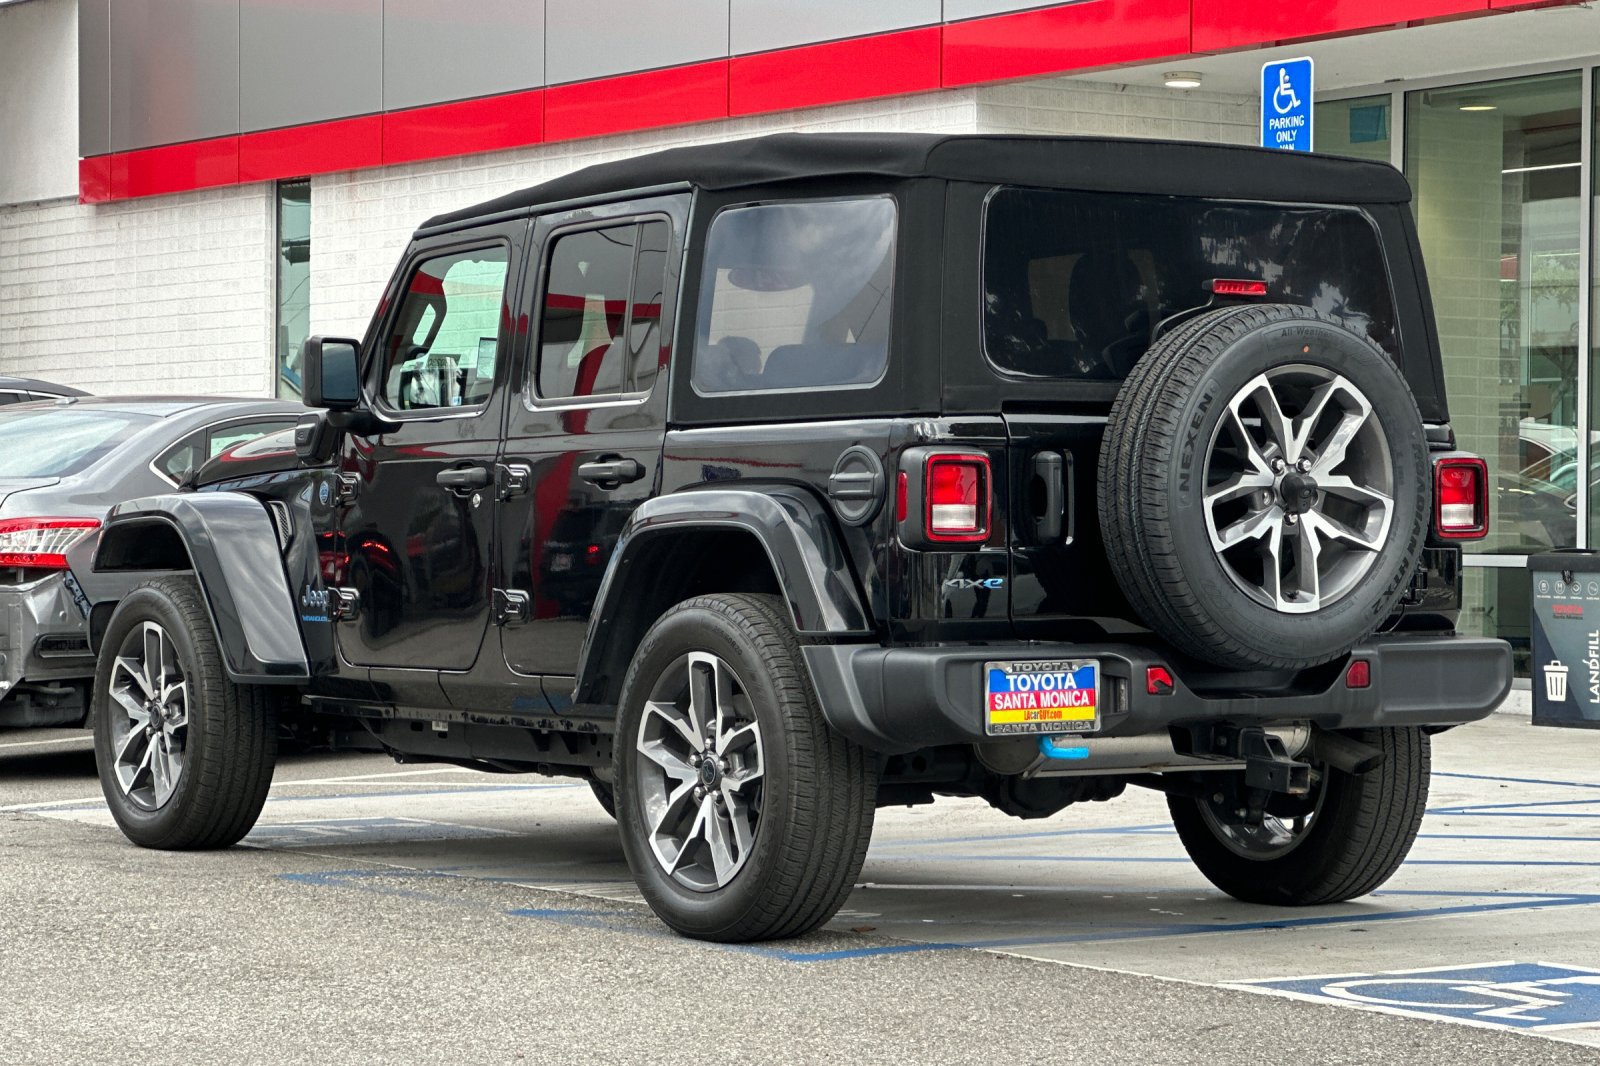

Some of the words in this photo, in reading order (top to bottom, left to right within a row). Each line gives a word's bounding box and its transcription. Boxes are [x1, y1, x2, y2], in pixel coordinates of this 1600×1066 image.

[1269, 115, 1305, 130] PARKING
[1276, 129, 1298, 143] ONLY
[1179, 393, 1213, 492] NEXEN
[302, 585, 329, 612] Jeep
[1013, 661, 1070, 672] TOYOTA
[1588, 629, 1600, 704] LANDFILL
[1005, 672, 1077, 691] TOYOTA
[994, 692, 1037, 710] SANTA
[1040, 690, 1090, 708] MONICA
[994, 723, 1038, 733] SANTA
[1040, 721, 1092, 732] MONICA
